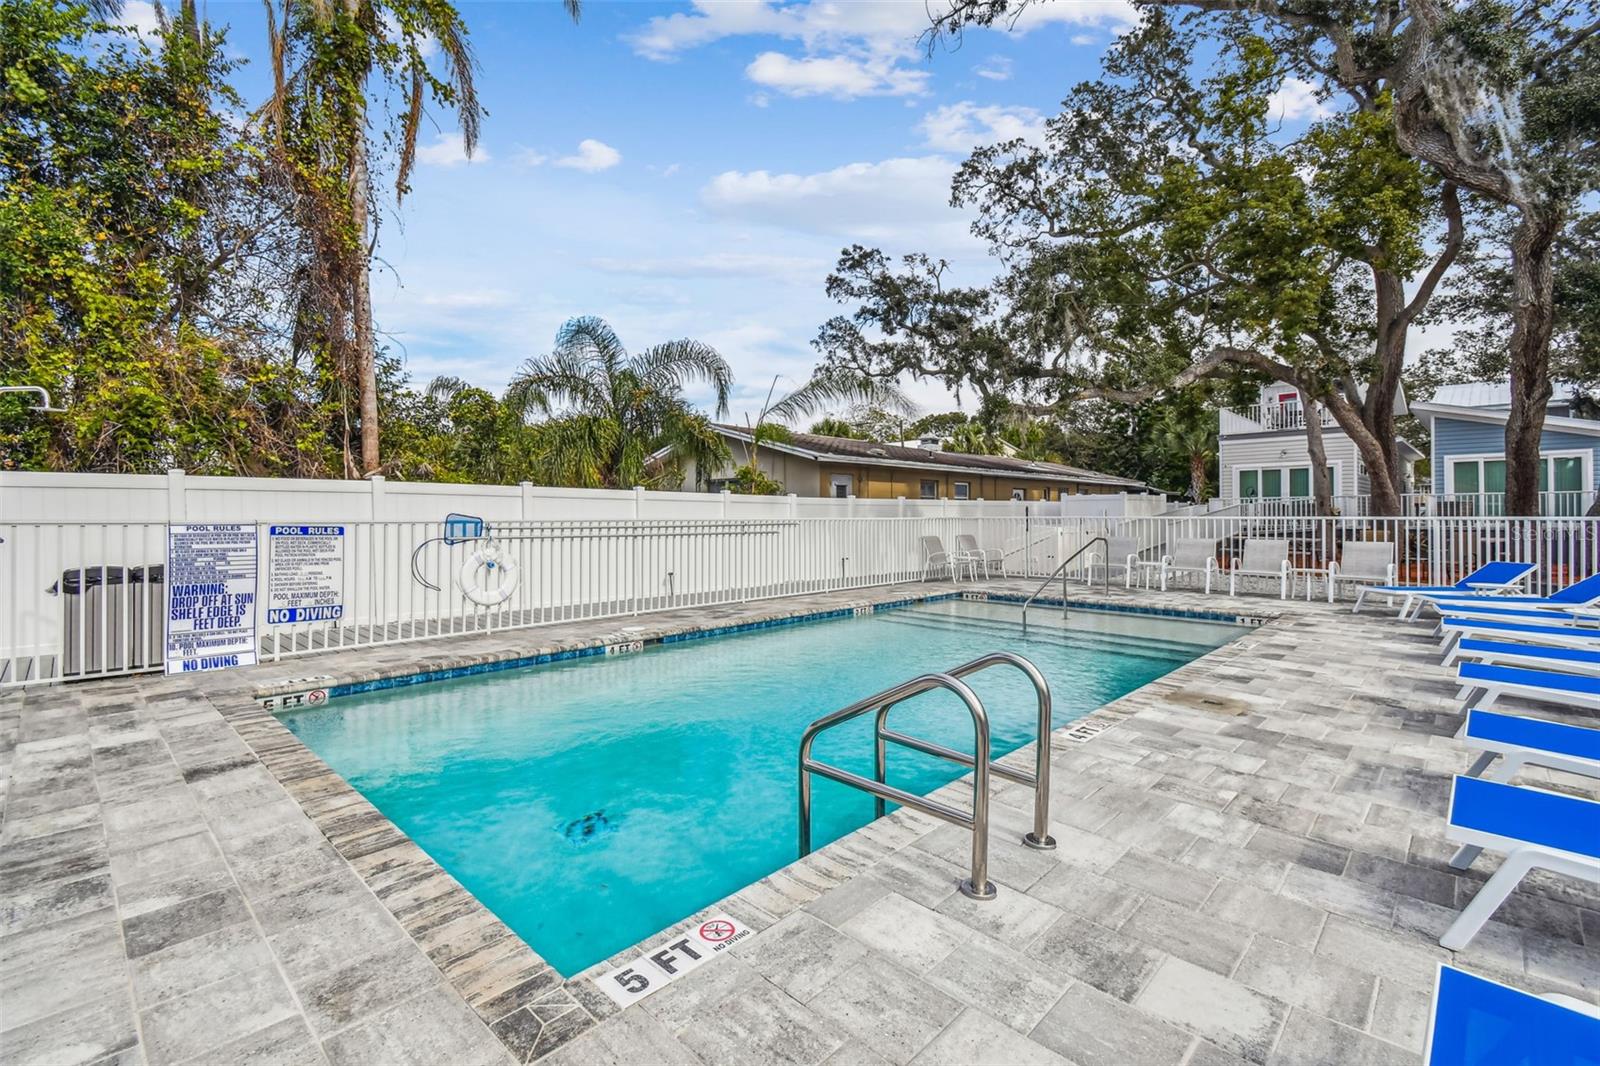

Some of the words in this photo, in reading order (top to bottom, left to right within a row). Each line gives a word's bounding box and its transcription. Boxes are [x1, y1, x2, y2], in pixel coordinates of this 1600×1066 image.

[275, 527, 304, 535] POOL
[308, 526, 340, 535] RULES
[172, 583, 228, 597] WARNING:
[291, 591, 318, 599] MAXIMUM
[172, 596, 199, 609] DROP
[201, 594, 218, 607] OFF
[220, 594, 232, 606] AT
[234, 592, 254, 604] SUN
[171, 607, 204, 620] SHELF
[207, 605, 234, 618] EDGE
[236, 604, 246, 616] IS
[270, 610, 290, 623] NO
[296, 606, 340, 621] DIVING
[194, 618, 215, 630] FEET
[217, 616, 242, 628] DEEP.
[179, 642, 194, 650] POOL
[196, 639, 226, 649] MAXIMUM
[228, 636, 248, 646] DEPTH:
[182, 659, 198, 671] NO
[200, 655, 239, 670] DIVING
[282, 694, 304, 708] FT
[712, 943, 726, 952] NO
[727, 930, 750, 946] DIVING
[614, 968, 650, 994] 5
[650, 938, 702, 974] FT
